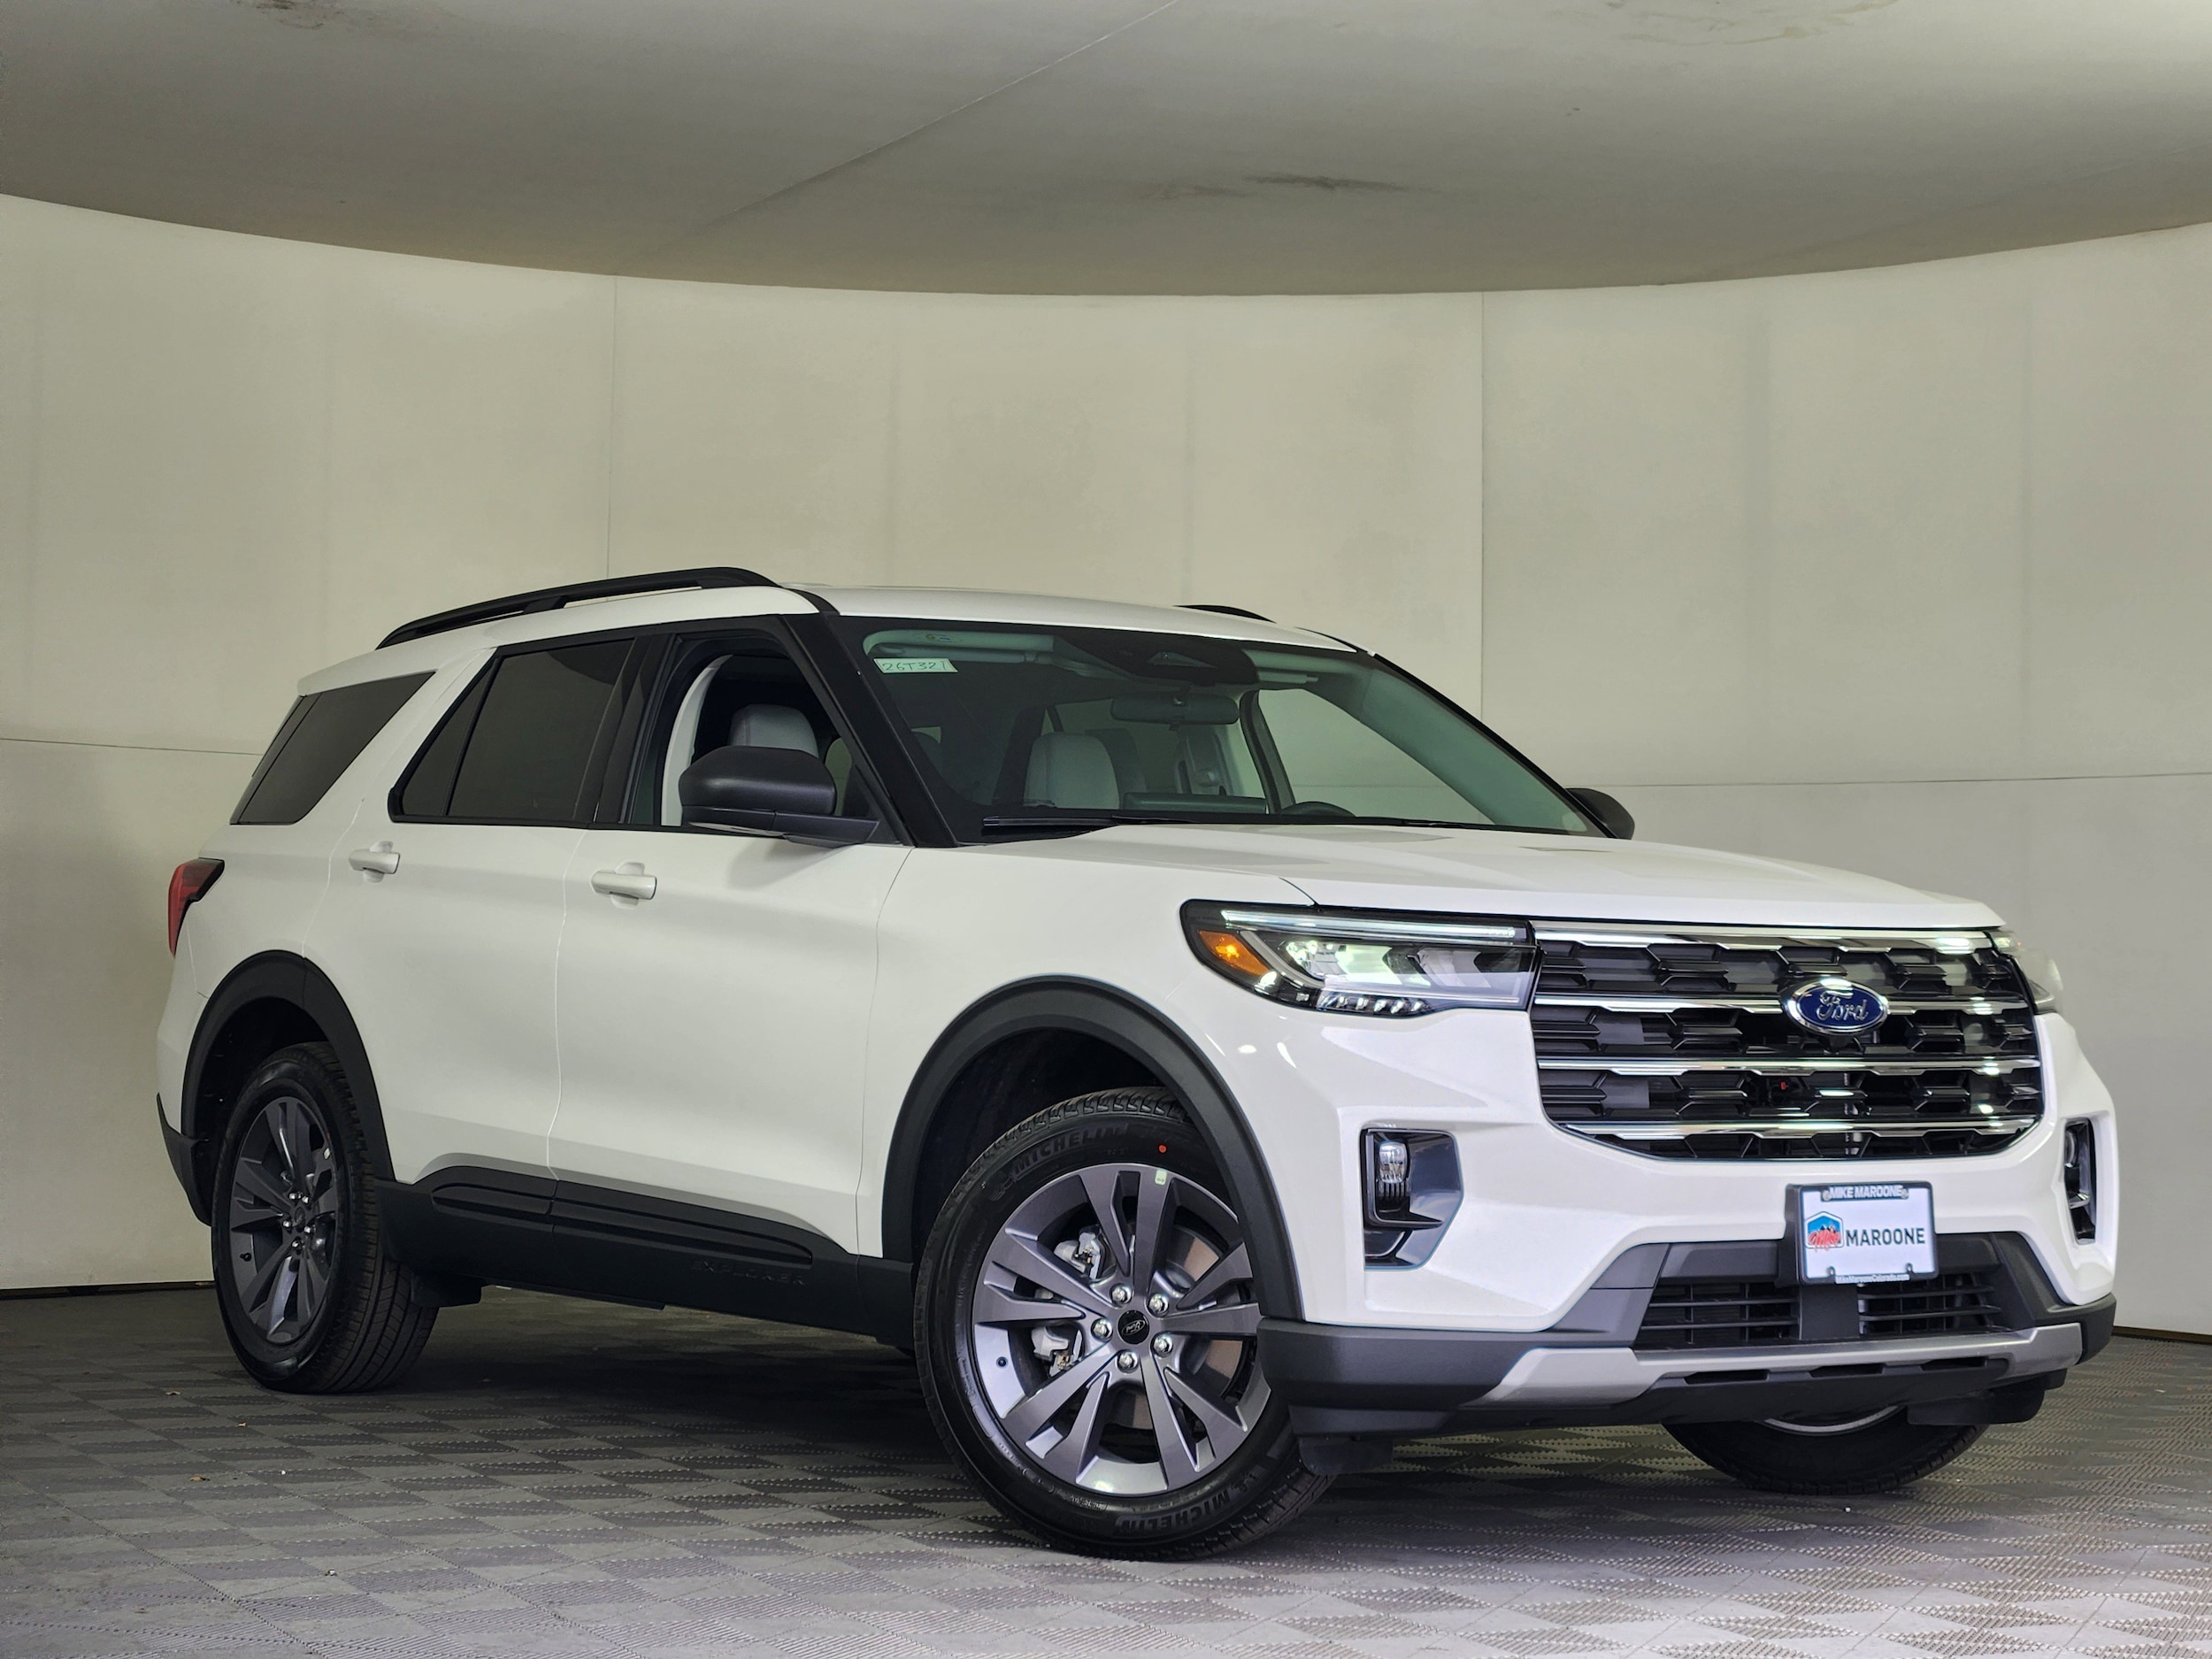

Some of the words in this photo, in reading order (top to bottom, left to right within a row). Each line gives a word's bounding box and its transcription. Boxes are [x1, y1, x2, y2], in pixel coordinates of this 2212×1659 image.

[1816, 990, 1869, 1020] Ford
[1016, 1126, 1122, 1172] MICHELIN
[1829, 1187, 1854, 1199] MIKE
[1855, 1185, 1903, 1198] MAROONE
[1846, 1228, 1925, 1247] MAROONE
[1119, 1489, 1232, 1531] MICHELIN
